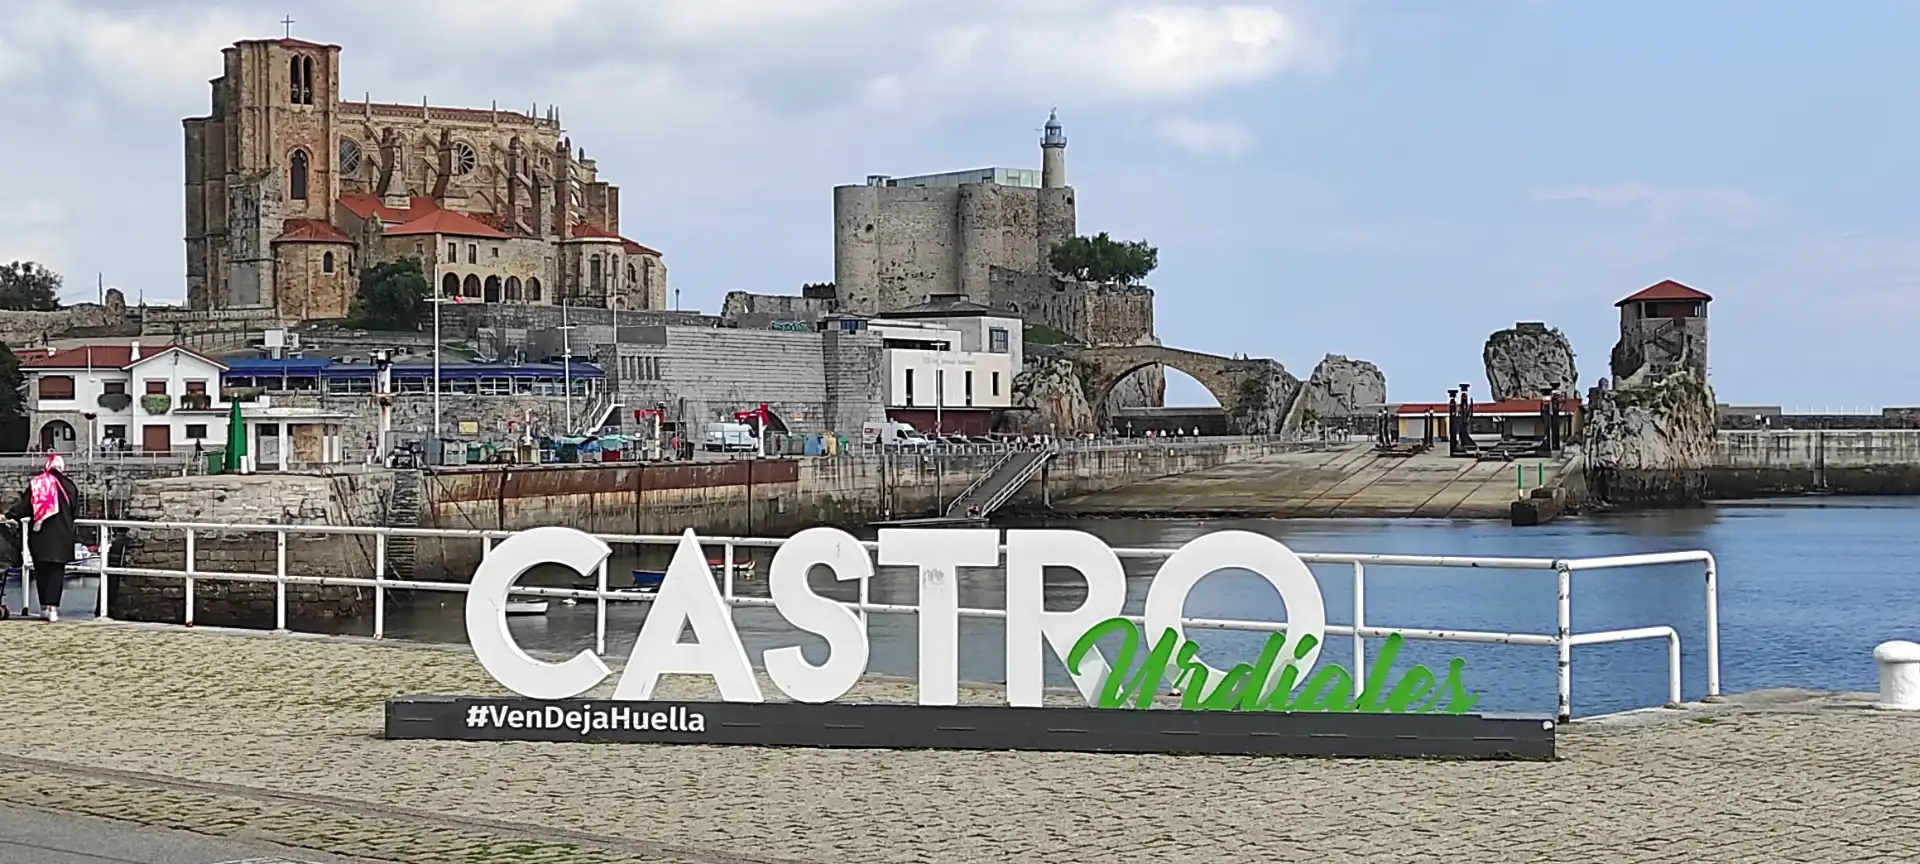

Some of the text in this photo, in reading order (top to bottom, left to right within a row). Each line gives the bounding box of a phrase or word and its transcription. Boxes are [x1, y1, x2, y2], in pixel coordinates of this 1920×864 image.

[466, 526, 1326, 708] CASTRO
[1067, 616, 1480, 714] Urdiales
[466, 704, 706, 735] #VenDejaHuella
